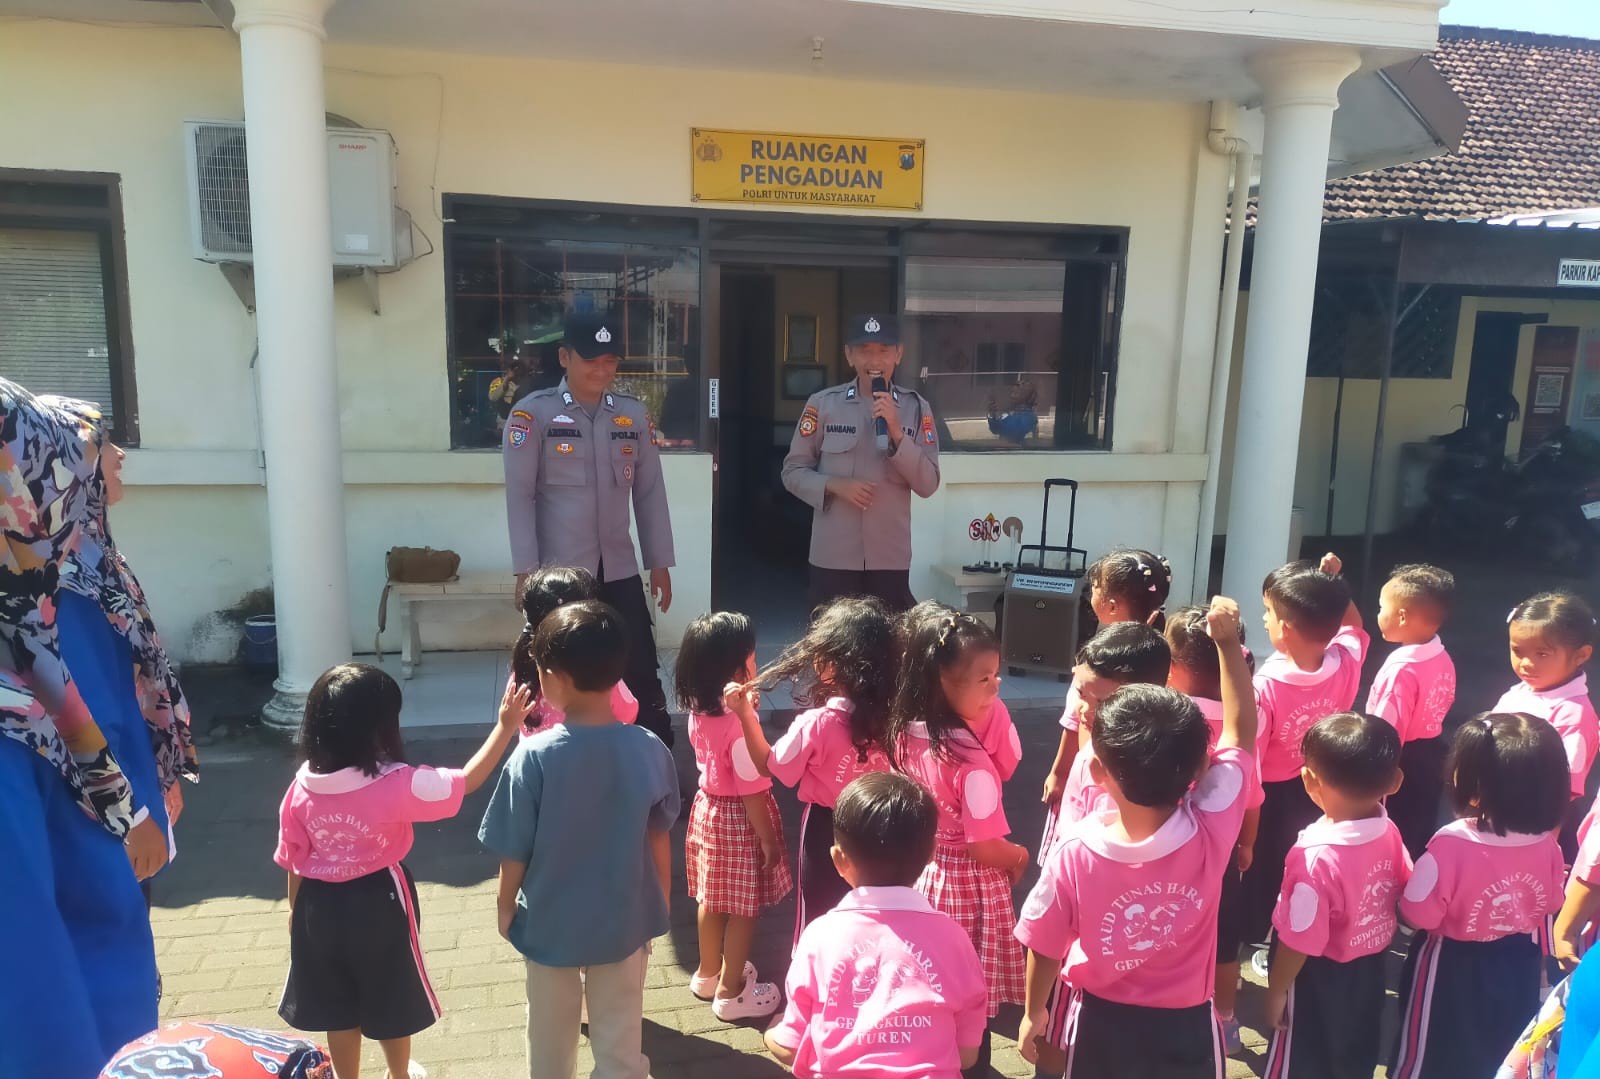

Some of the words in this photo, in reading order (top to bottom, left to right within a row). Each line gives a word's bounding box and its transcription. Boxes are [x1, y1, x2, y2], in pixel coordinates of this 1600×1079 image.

[751, 140, 867, 164] RUANGAN
[740, 164, 883, 189] PENGADUAN
[742, 189, 772, 199] POLRI
[774, 191, 808, 201] UNTUK
[809, 192, 876, 203] MASYARAKAT
[1560, 264, 1586, 281] PARKIR
[611, 431, 639, 441] POLRI
[836, 754, 851, 783] PAUD
[306, 813, 342, 833] TUNAS
[1466, 900, 1484, 933] PAUD
[1482, 872, 1521, 898] TUNAS
[1100, 912, 1116, 956] PAUD
[1112, 881, 1162, 910] TUNAS
[1167, 882, 1204, 911] HARA
[827, 961, 847, 1007] PAUD
[856, 1031, 912, 1045] TUREN
